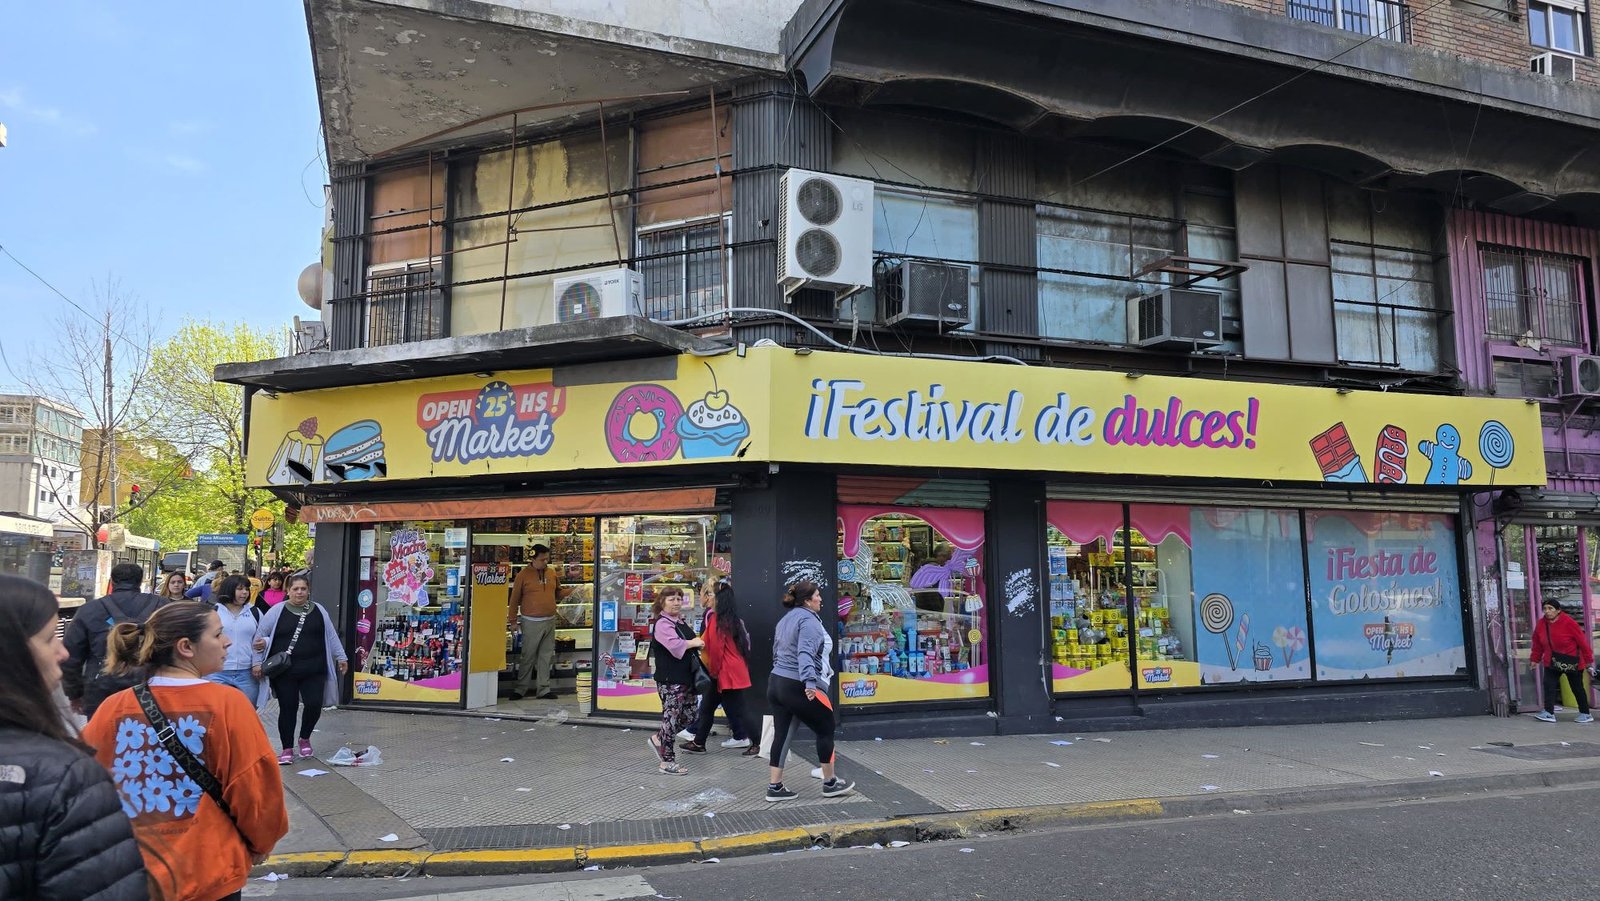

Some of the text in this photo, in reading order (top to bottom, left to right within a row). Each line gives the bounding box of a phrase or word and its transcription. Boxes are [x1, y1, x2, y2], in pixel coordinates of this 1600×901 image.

[422, 399, 472, 421] OPEN
[483, 396, 508, 418] 25
[1034, 392, 1096, 446] de
[1103, 394, 1259, 449] dulces!
[429, 413, 551, 459] Market
[392, 542, 427, 559] Madre
[1409, 545, 1438, 576] de
[477, 571, 506, 584] Market
[1329, 577, 1442, 615] Golosinas!
[291, 627, 302, 642] LOVE
[1366, 626, 1384, 635] OPEN
[845, 687, 874, 696] Market
